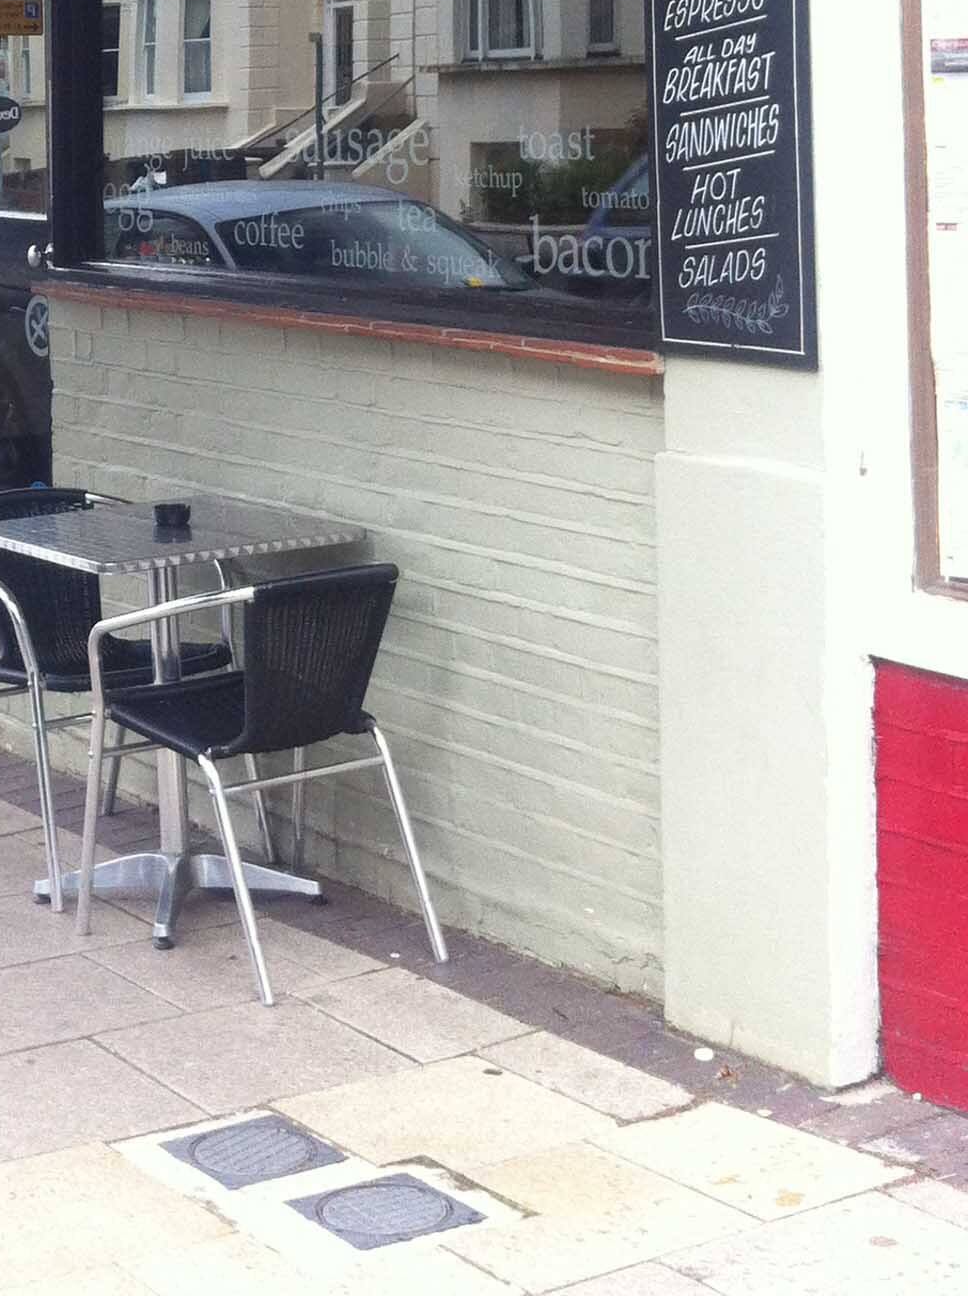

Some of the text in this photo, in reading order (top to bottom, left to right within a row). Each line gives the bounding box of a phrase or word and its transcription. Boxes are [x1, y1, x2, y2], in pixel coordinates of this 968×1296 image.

[683, 32, 757, 65] ALL DAY
[663, 51, 776, 104] BREAKFAST
[518, 124, 596, 161] toast
[665, 104, 780, 164] SANDWICHES
[283, 127, 430, 185] sausage
[454, 163, 523, 198] ketchup
[582, 186, 650, 210] tomato
[690, 168, 742, 204] HOT
[234, 204, 305, 250] coffee
[396, 196, 438, 233] tea
[670, 195, 766, 241] LUNCHES
[169, 234, 209, 256] beans
[331, 239, 502, 285] bubble & squeak
[678, 247, 767, 289] SALADS
